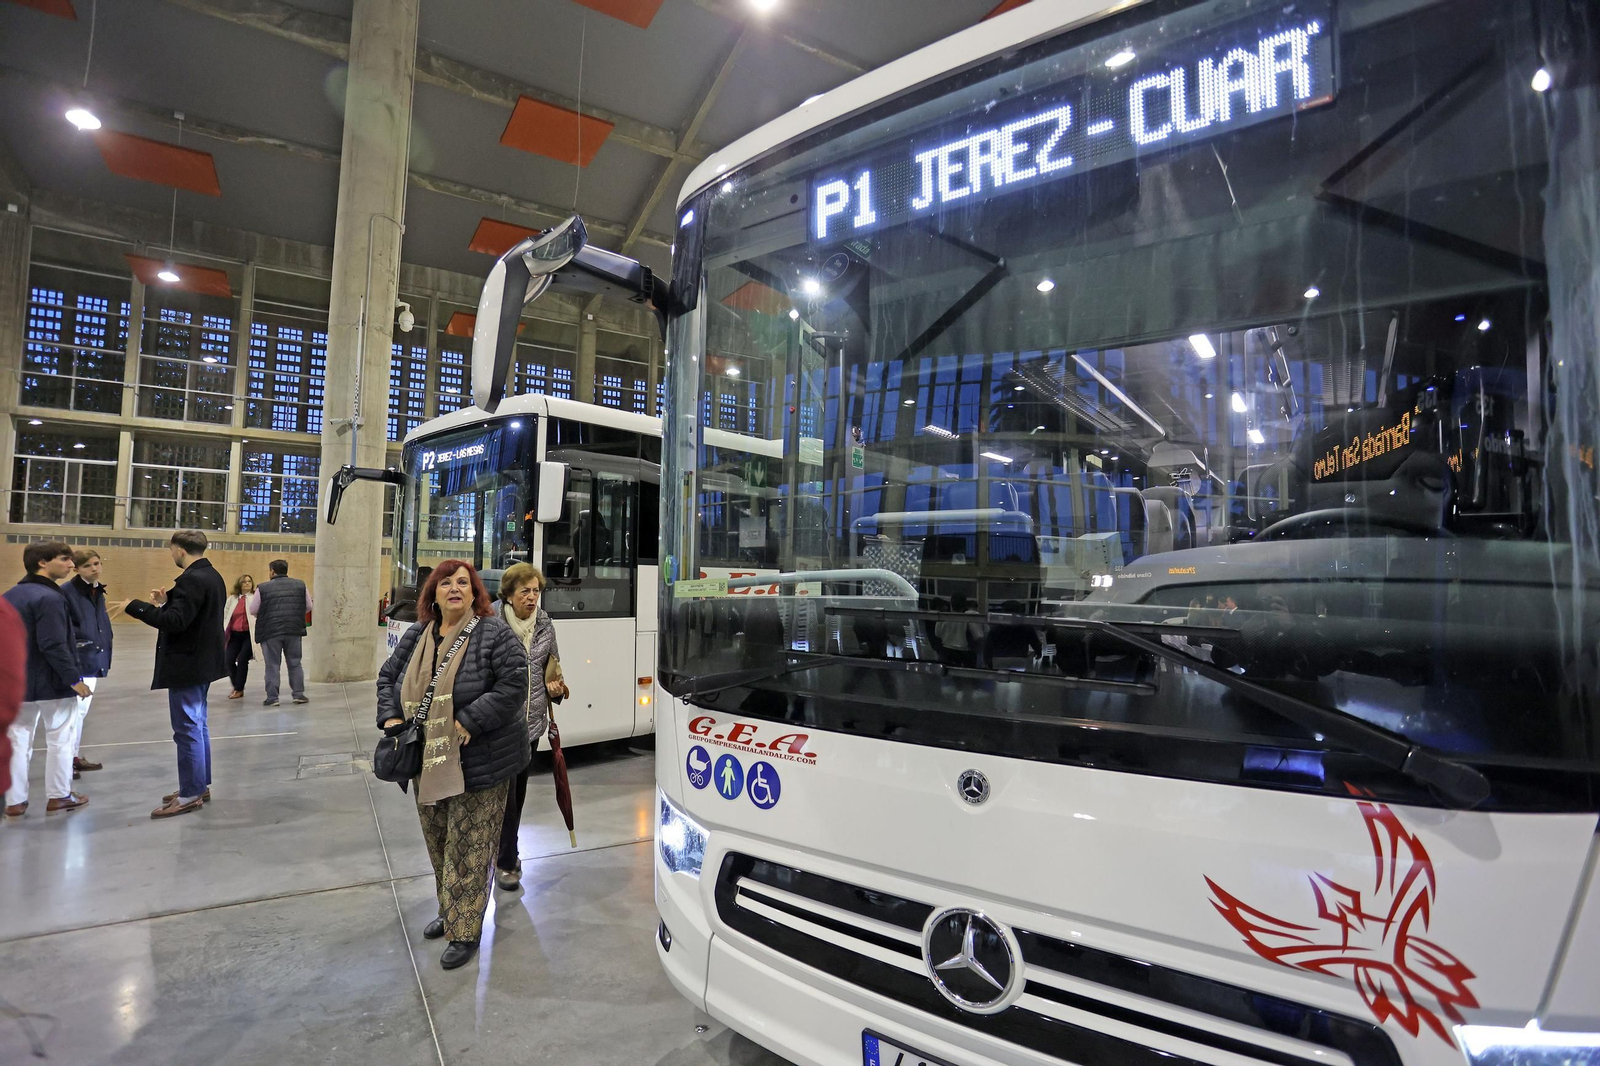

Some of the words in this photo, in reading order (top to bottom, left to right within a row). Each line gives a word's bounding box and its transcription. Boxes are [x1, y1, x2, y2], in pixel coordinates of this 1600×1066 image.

[815, 170, 877, 240] P1
[911, 104, 1074, 211] JEREZ
[1129, 20, 1320, 145] CUAR
[422, 451, 436, 471] P2
[417, 691, 433, 720] BIMBA
[430, 661, 448, 687] BIMBA
[446, 635, 467, 659] BIMBA
[463, 615, 481, 634] BIMBA
[688, 716, 818, 758] G.E.A.
[688, 734, 817, 765] GRUPOEMPRESARIALANDALUZ.COM
